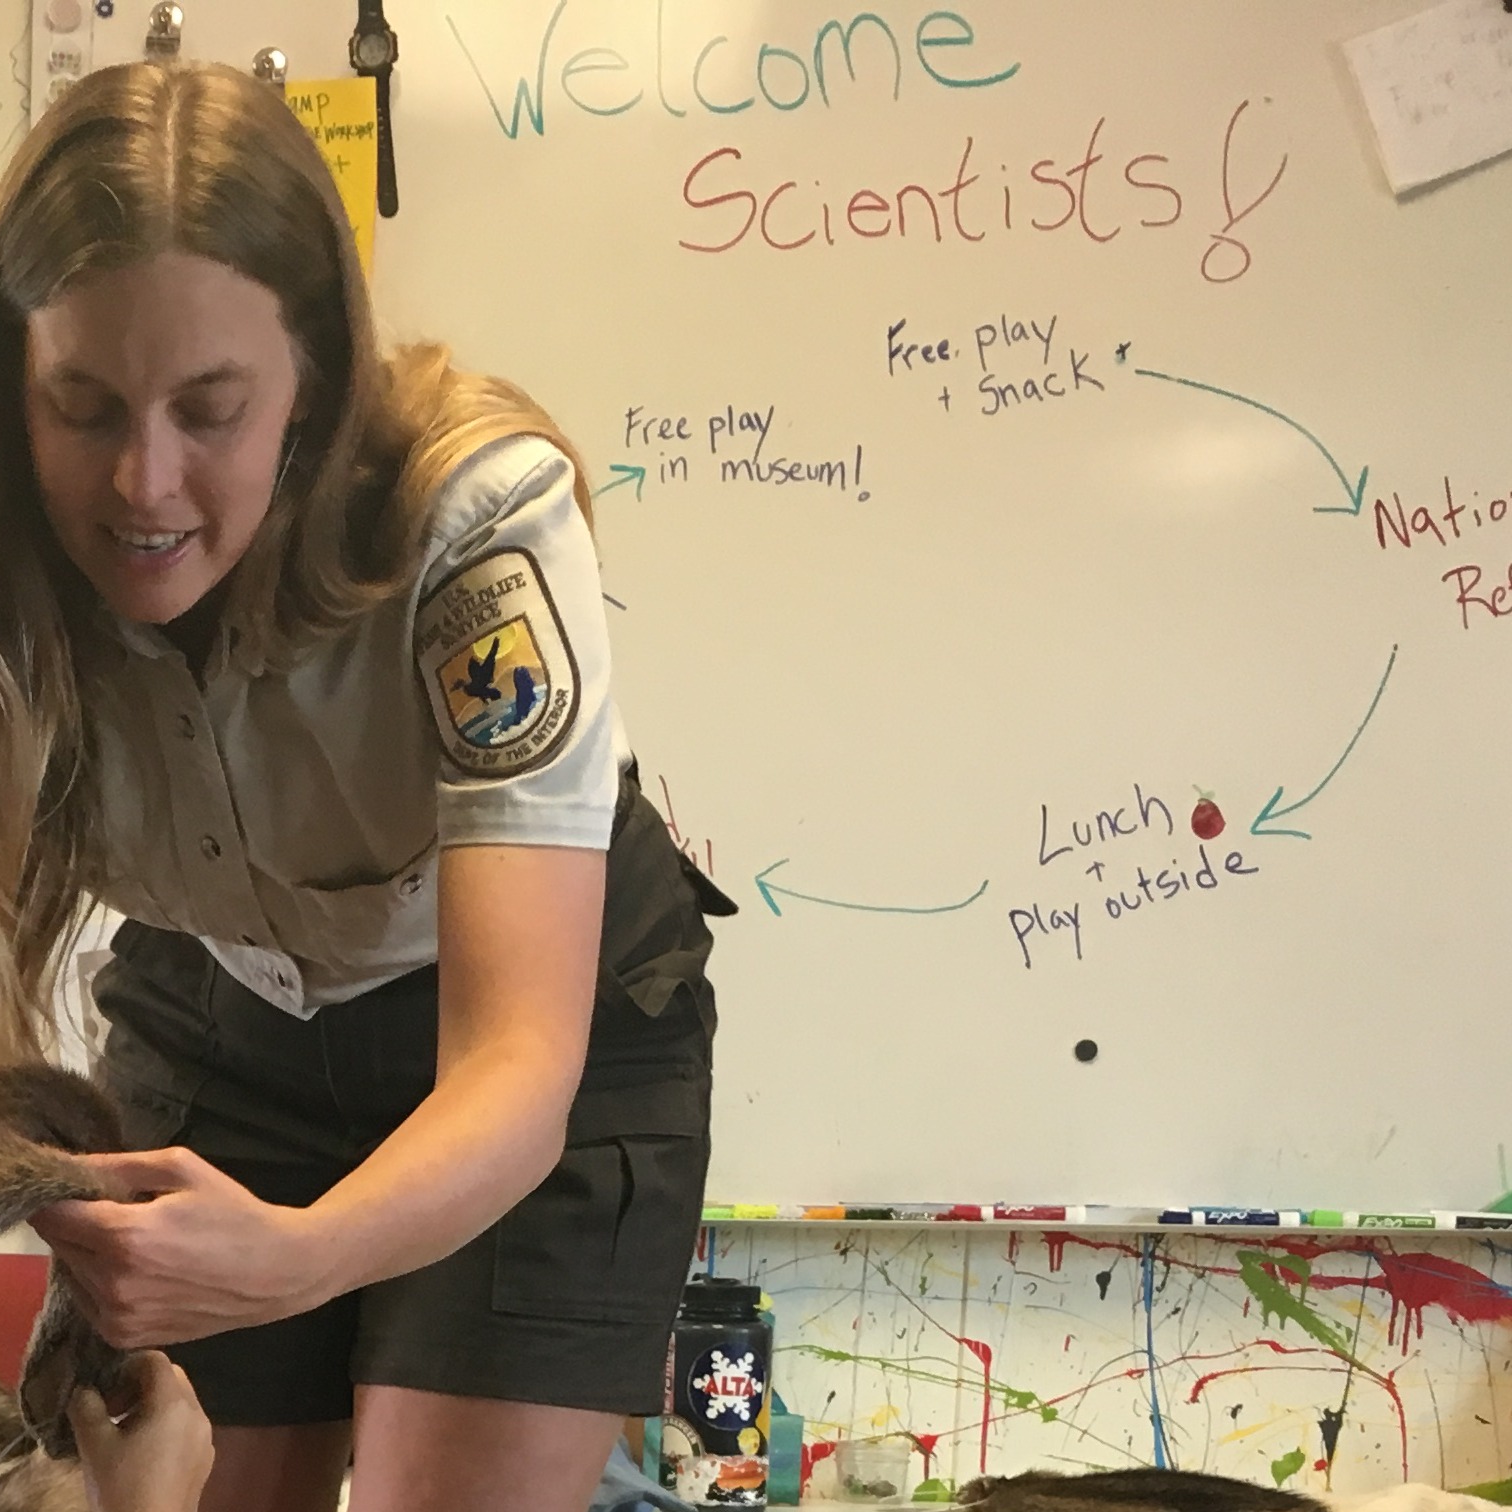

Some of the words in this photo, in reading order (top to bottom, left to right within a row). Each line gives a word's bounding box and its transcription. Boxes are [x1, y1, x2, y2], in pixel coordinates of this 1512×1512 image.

[445, 0, 1020, 140] Welcome
[975, 313, 1058, 372] play
[978, 348, 1105, 416] Snack
[624, 405, 692, 448] Free
[708, 404, 775, 466] play
[659, 451, 688, 484] in
[721, 444, 871, 502] museum!
[1374, 475, 1512, 550] Natio
[1441, 563, 1512, 630] Re
[506, 742, 533, 761] THE
[1038, 783, 1174, 867] Lunch
[1008, 902, 1083, 970] play
[1105, 844, 1260, 919] outside
[704, 1376, 755, 1396] ALTA
